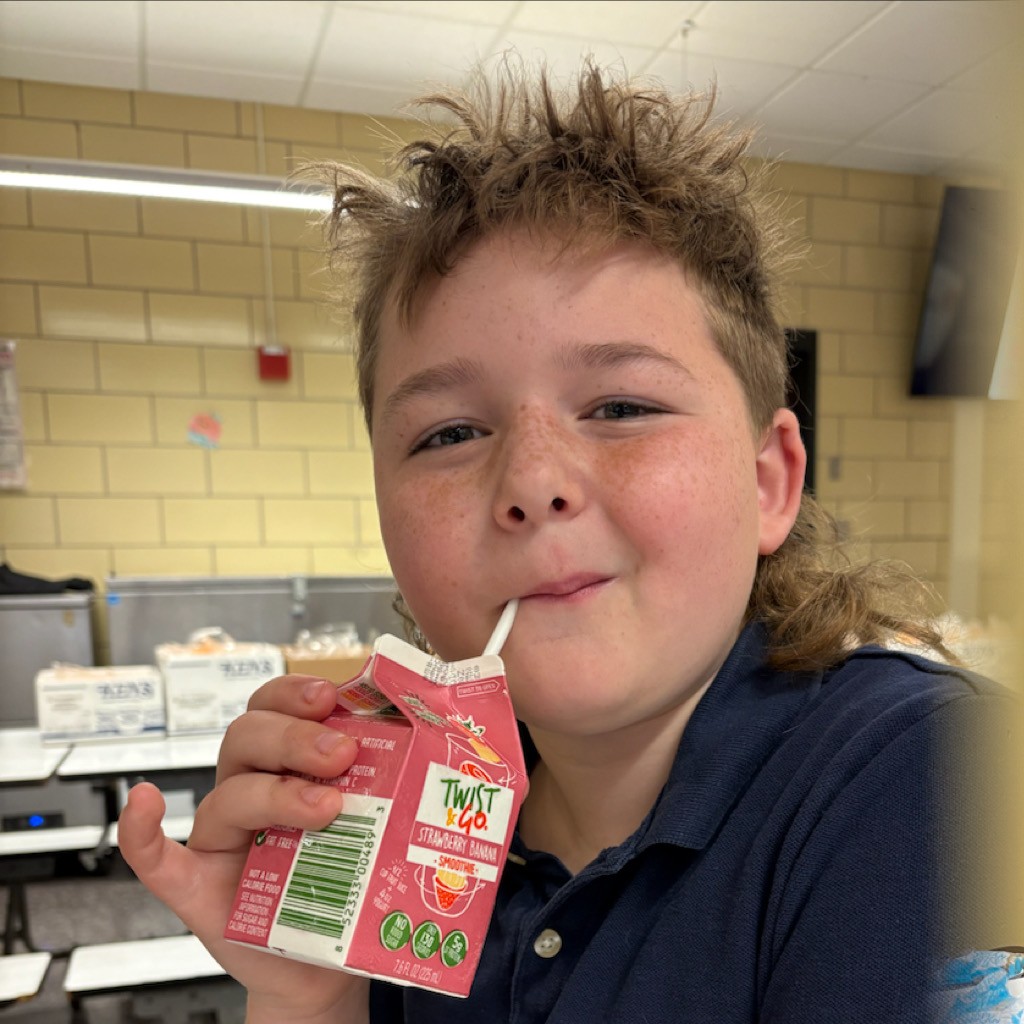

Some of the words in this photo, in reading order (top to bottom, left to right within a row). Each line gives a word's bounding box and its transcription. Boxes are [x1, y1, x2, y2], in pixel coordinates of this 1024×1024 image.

[440, 778, 501, 814] TWIST
[446, 807, 457, 827] &
[418, 827, 469, 855] STRAWBERRY
[469, 841, 498, 862] BANANA
[438, 855, 476, 875] SMOOTHIE
[341, 881, 362, 926] 52333
[395, 914, 408, 931] NO
